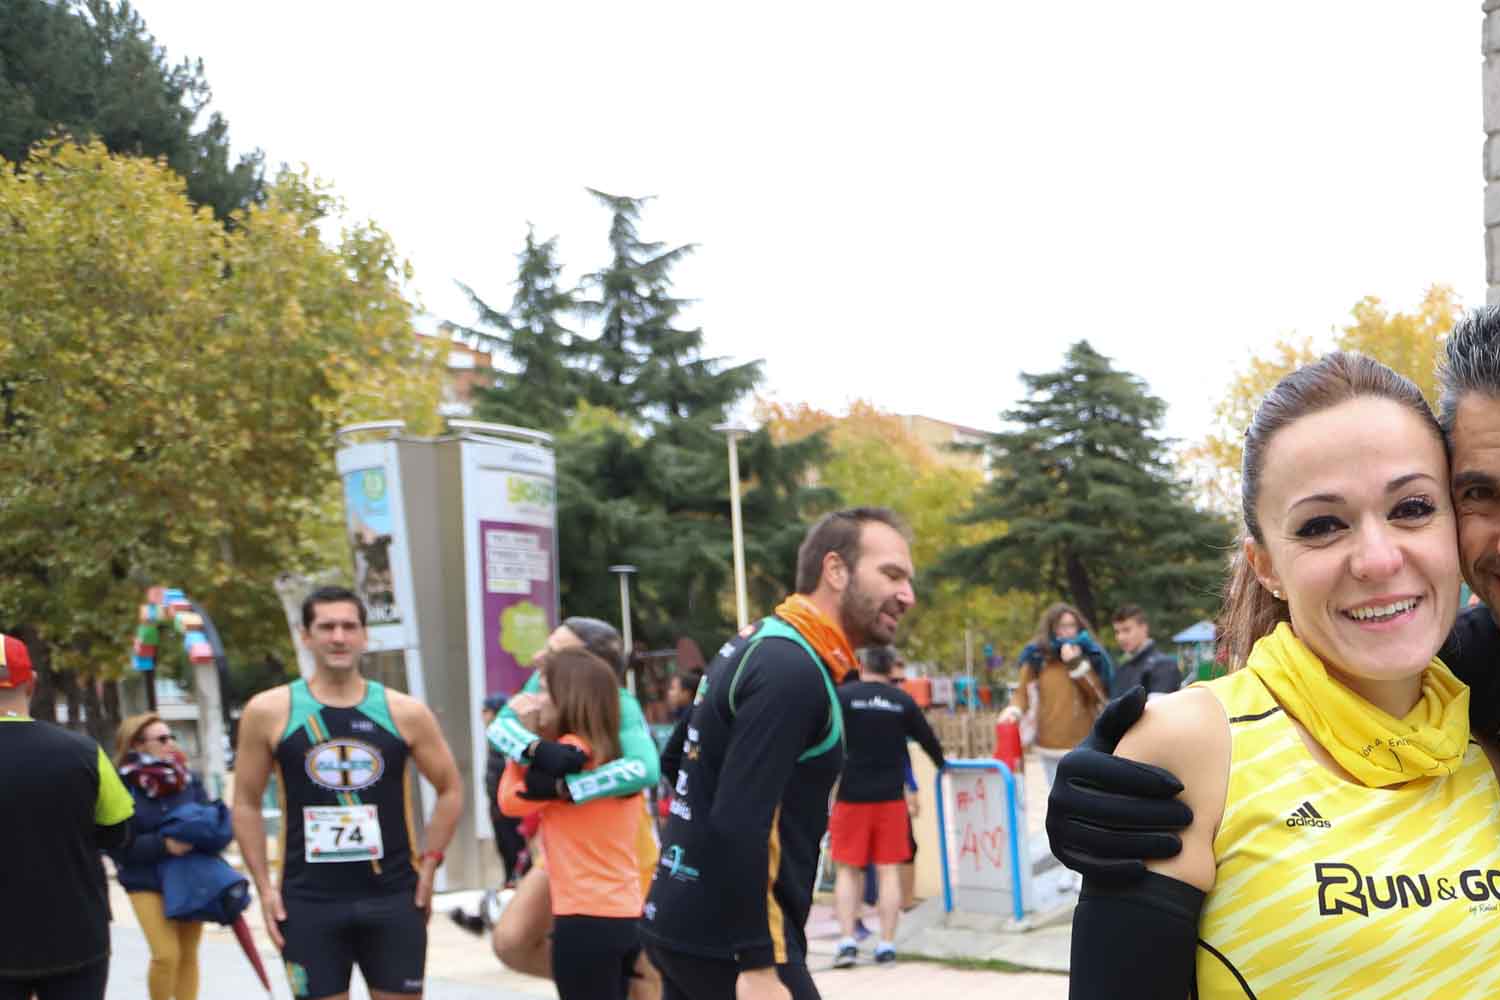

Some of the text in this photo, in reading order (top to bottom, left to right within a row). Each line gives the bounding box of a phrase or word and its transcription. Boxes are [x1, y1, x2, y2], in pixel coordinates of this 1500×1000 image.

[1286, 813, 1332, 829] adidas
[330, 826, 364, 847] 74
[1314, 863, 1432, 917] RUN
[1437, 877, 1458, 900] &
